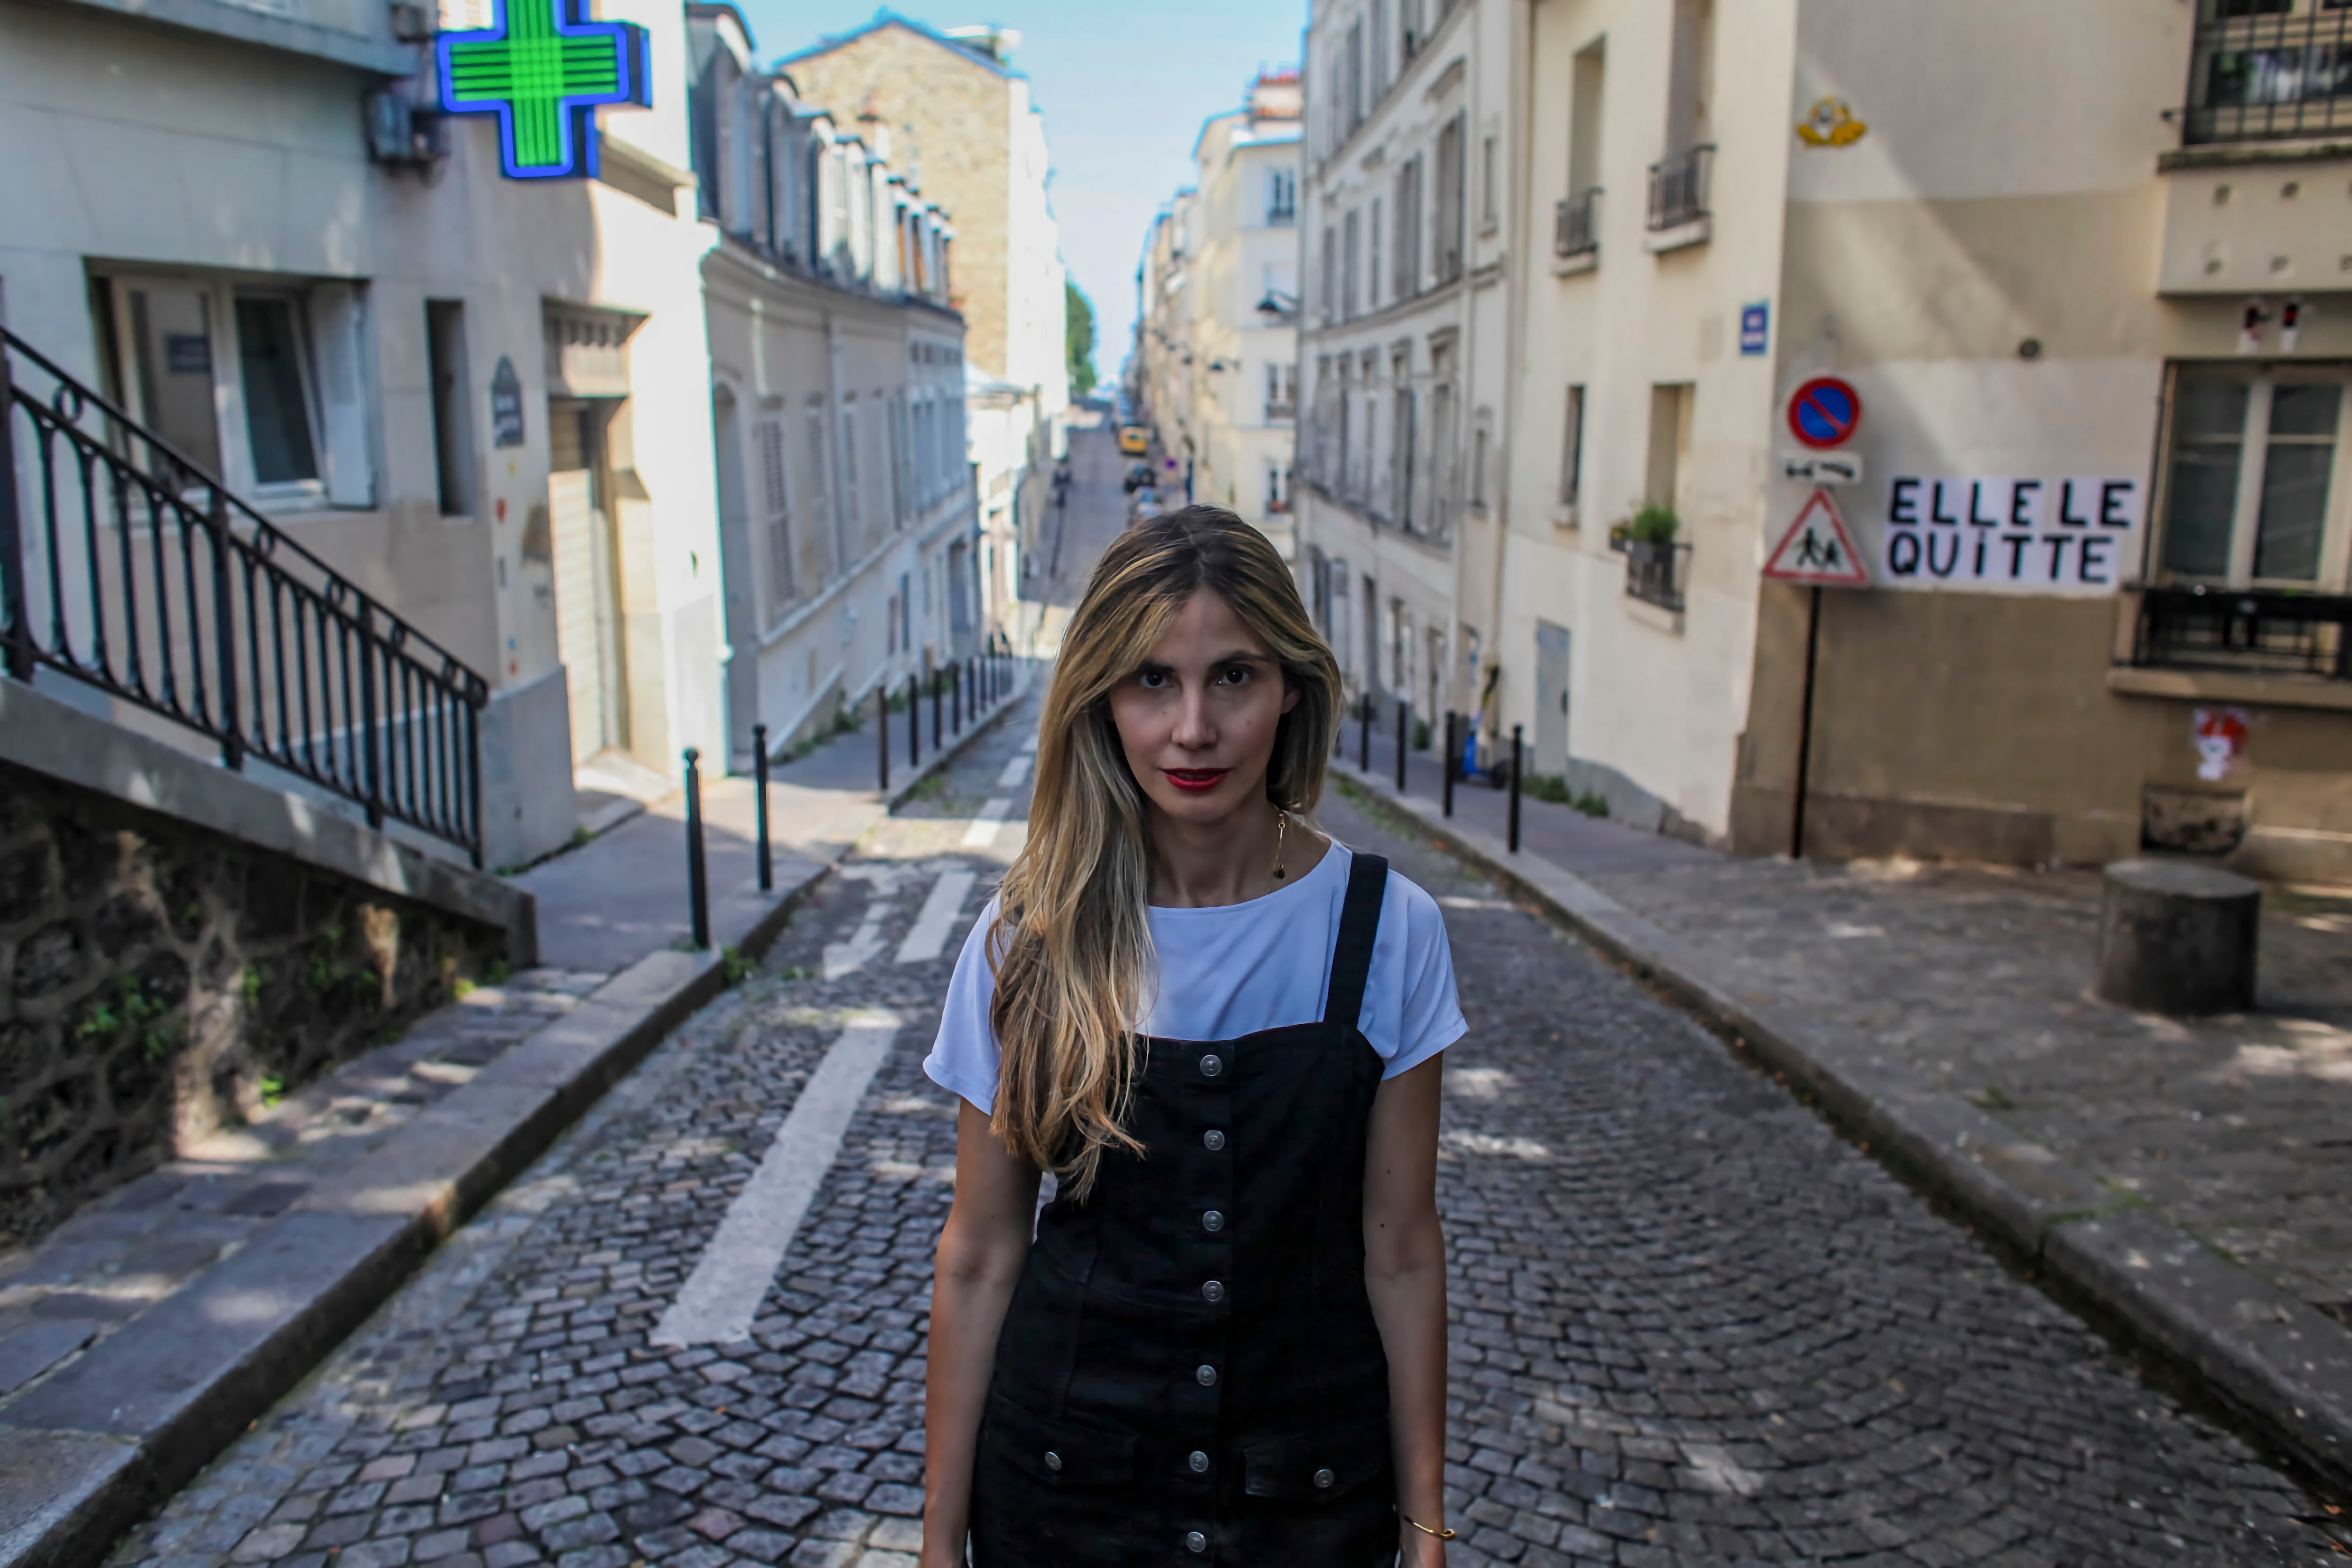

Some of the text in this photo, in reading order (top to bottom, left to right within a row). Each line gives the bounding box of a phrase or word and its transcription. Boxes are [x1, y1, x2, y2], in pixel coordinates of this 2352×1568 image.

[1887, 477, 2134, 529] ELLE LE
[1887, 530, 2112, 583] QUITTE
